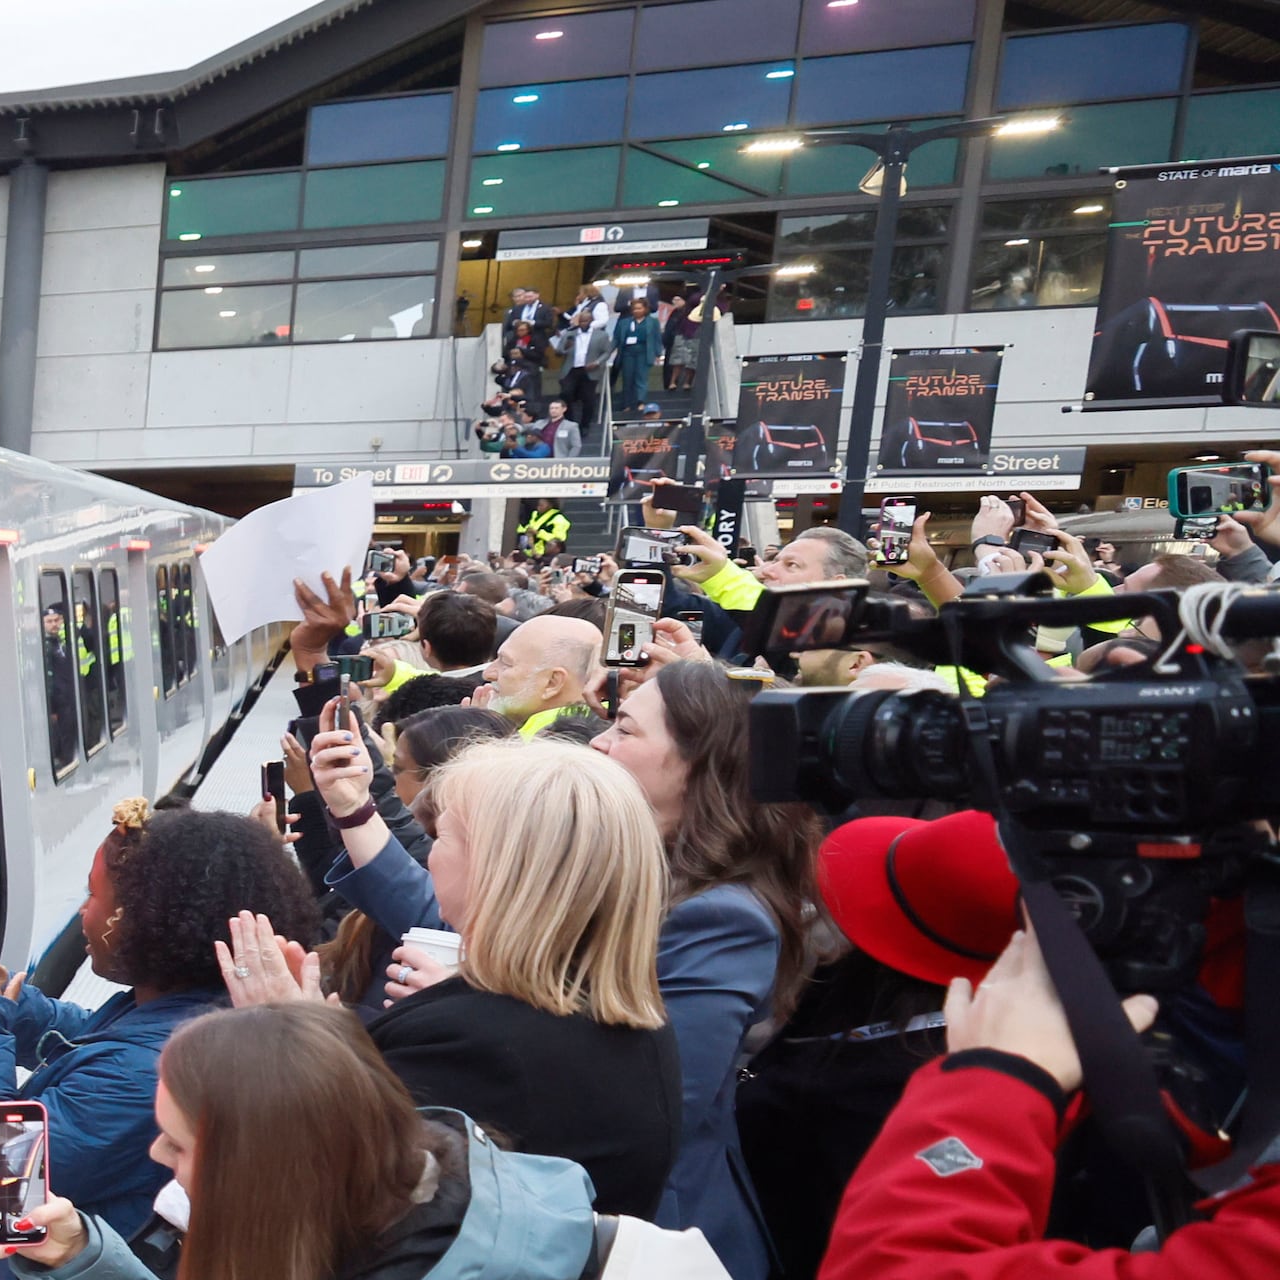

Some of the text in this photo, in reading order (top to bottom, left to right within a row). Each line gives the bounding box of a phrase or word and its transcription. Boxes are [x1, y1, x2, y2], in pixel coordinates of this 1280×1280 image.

[1157, 163, 1272, 182] STATE OF marta
[1146, 206, 1181, 217] NEXT
[756, 379, 827, 392] FUTURE
[906, 374, 982, 386] FUTURE
[755, 389, 832, 402] TRANSIT
[906, 384, 987, 397] TRANSIT
[992, 454, 1060, 471] Street
[312, 467, 333, 484] To
[339, 466, 392, 482] Stet
